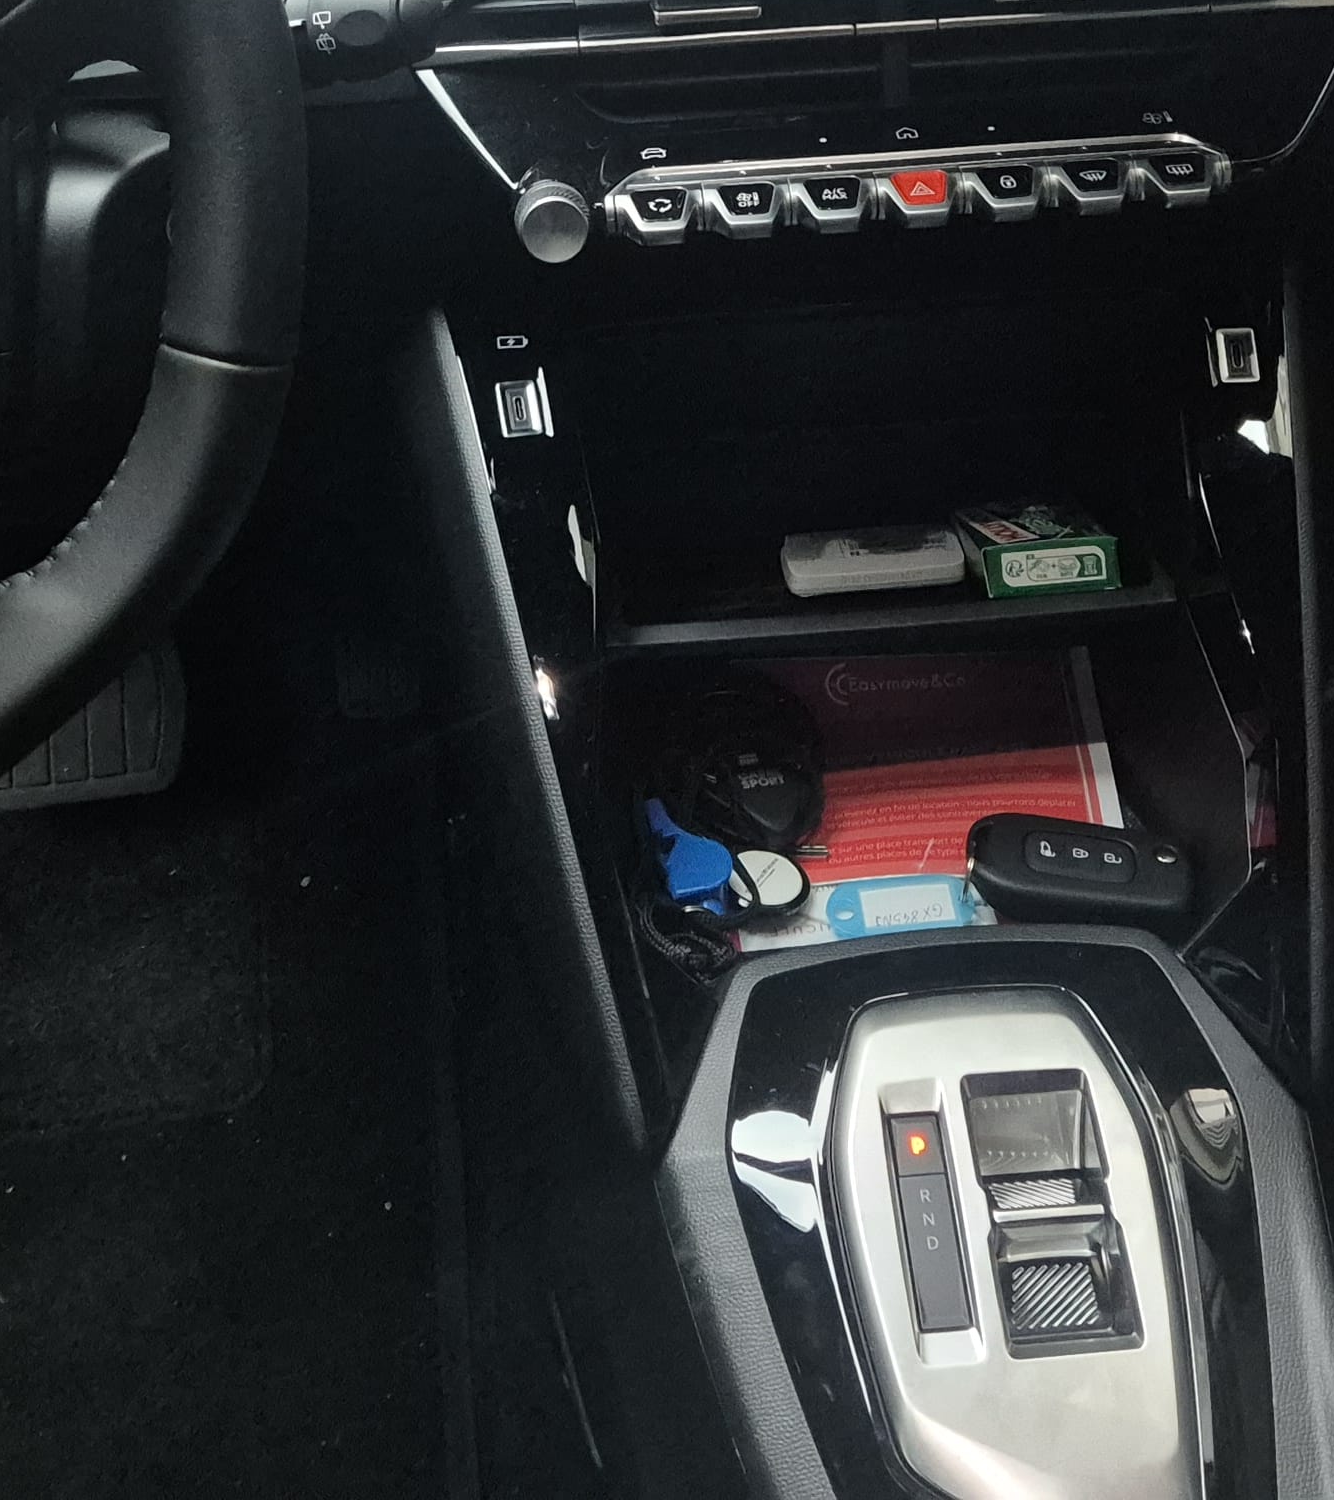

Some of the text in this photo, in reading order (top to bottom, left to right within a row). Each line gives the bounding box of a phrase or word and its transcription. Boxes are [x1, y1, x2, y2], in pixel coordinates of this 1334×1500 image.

[856, 843, 874, 852] une
[876, 840, 902, 851] place
[876, 849, 908, 861] places
[910, 1135, 925, 1154] P
[919, 1188, 932, 1203] R
[923, 1212, 936, 1228] N
[926, 1236, 940, 1251] D
